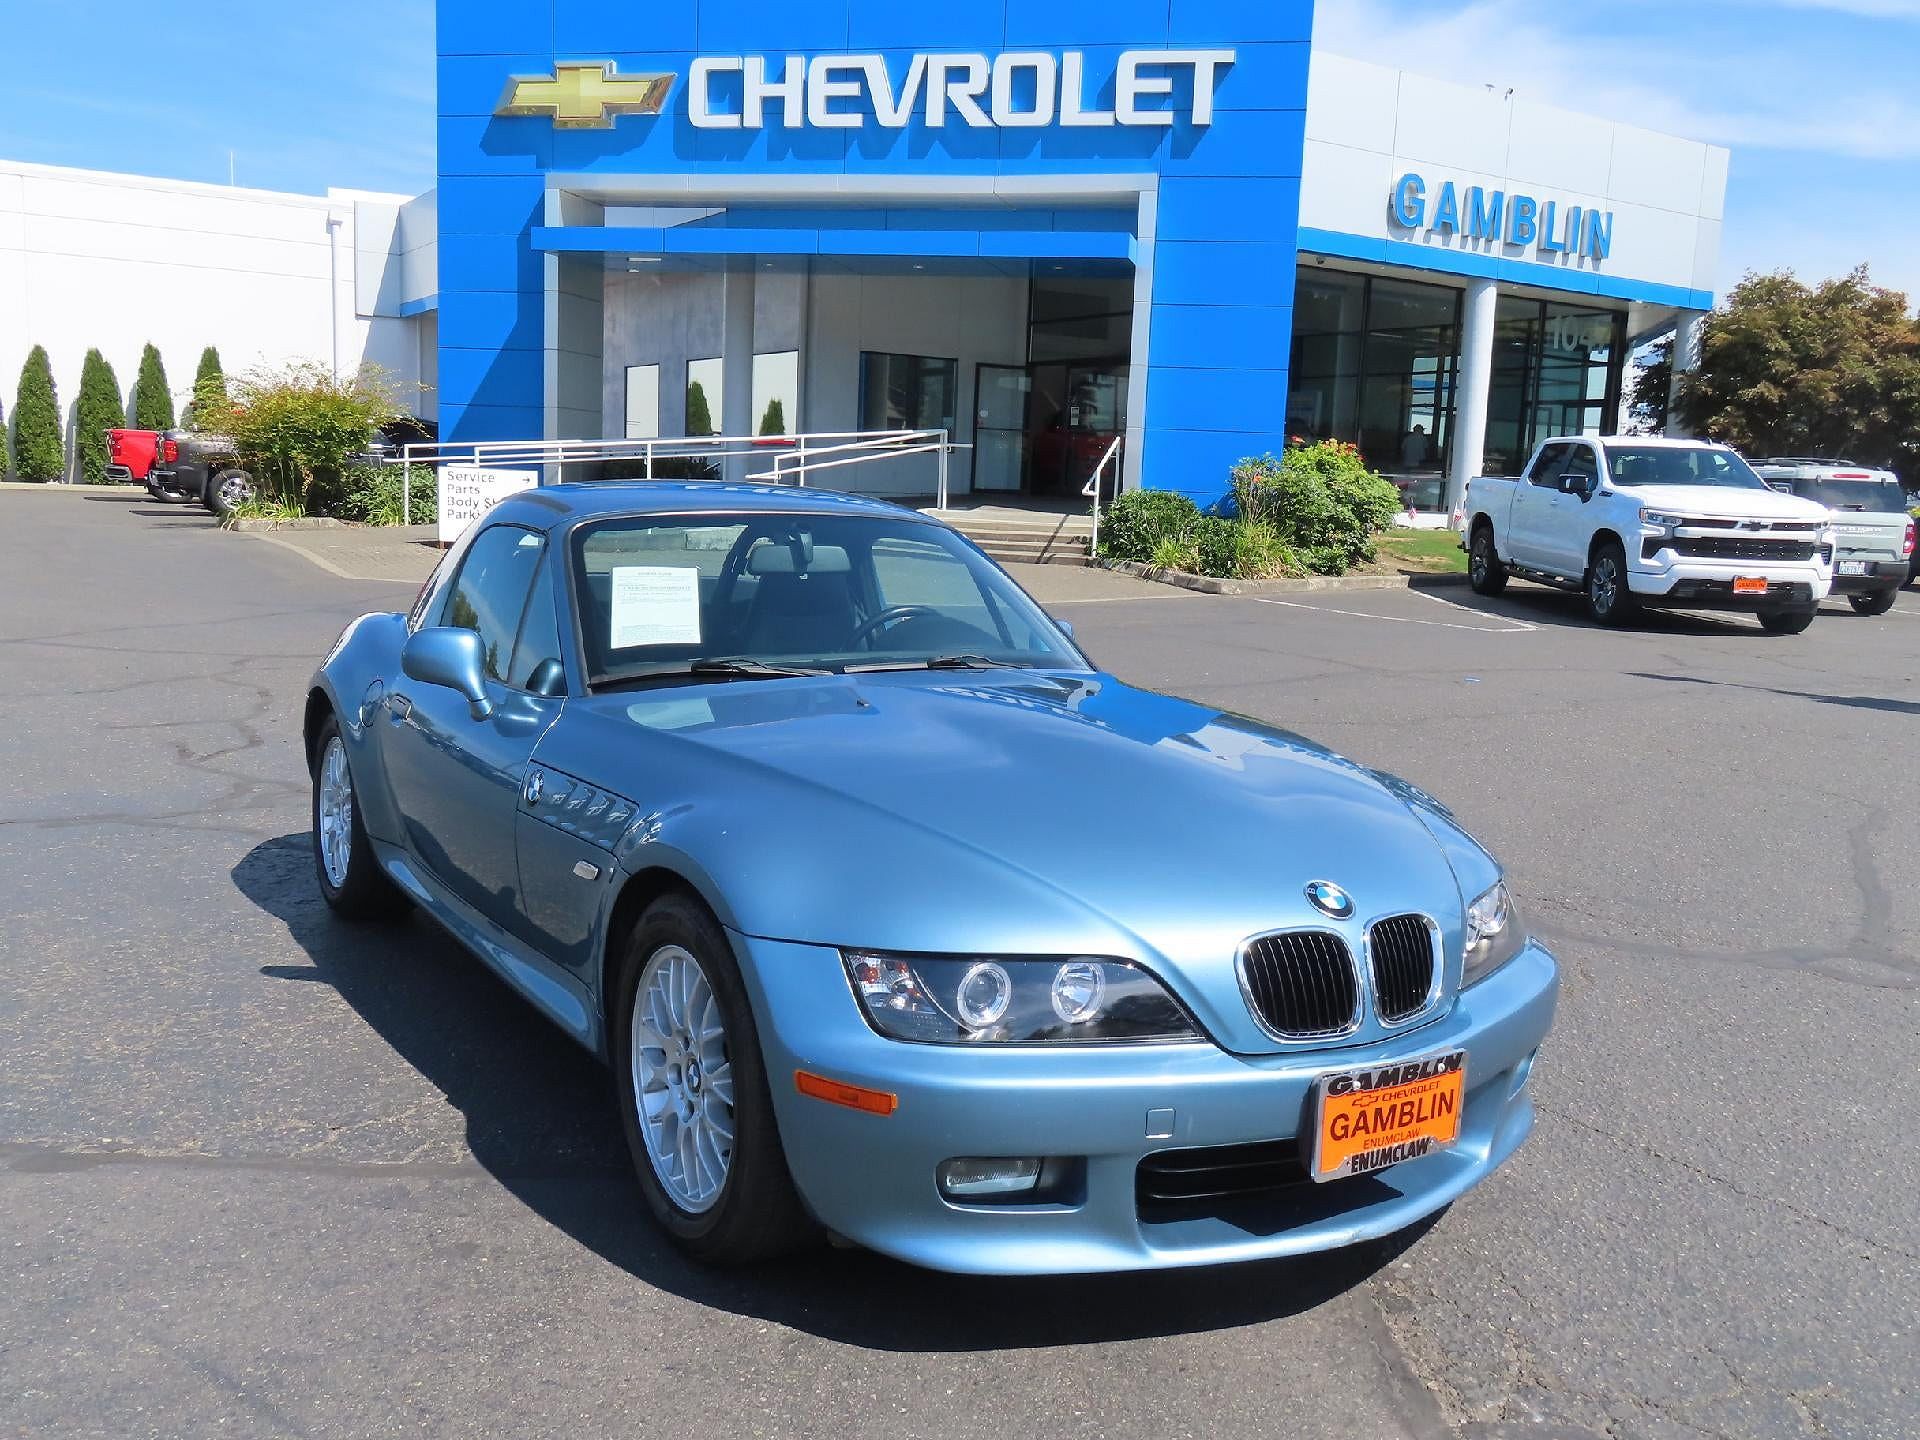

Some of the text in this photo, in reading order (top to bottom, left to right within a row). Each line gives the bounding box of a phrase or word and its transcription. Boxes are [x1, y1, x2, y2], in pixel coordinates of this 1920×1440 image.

[688, 49, 1236, 128] CHEVROLET
[1392, 173, 1614, 259] GAMBLIN
[447, 470, 495, 483] Service
[447, 484, 480, 494] Parts
[447, 496, 479, 509] Body
[447, 509, 480, 519] Park
[1382, 1081, 1441, 1102] CHEVROLET
[1330, 1088, 1455, 1141] GAMBLIN
[1362, 1127, 1421, 1150] ENUMCLAW
[1351, 1136, 1431, 1173] ENUMCLAW
